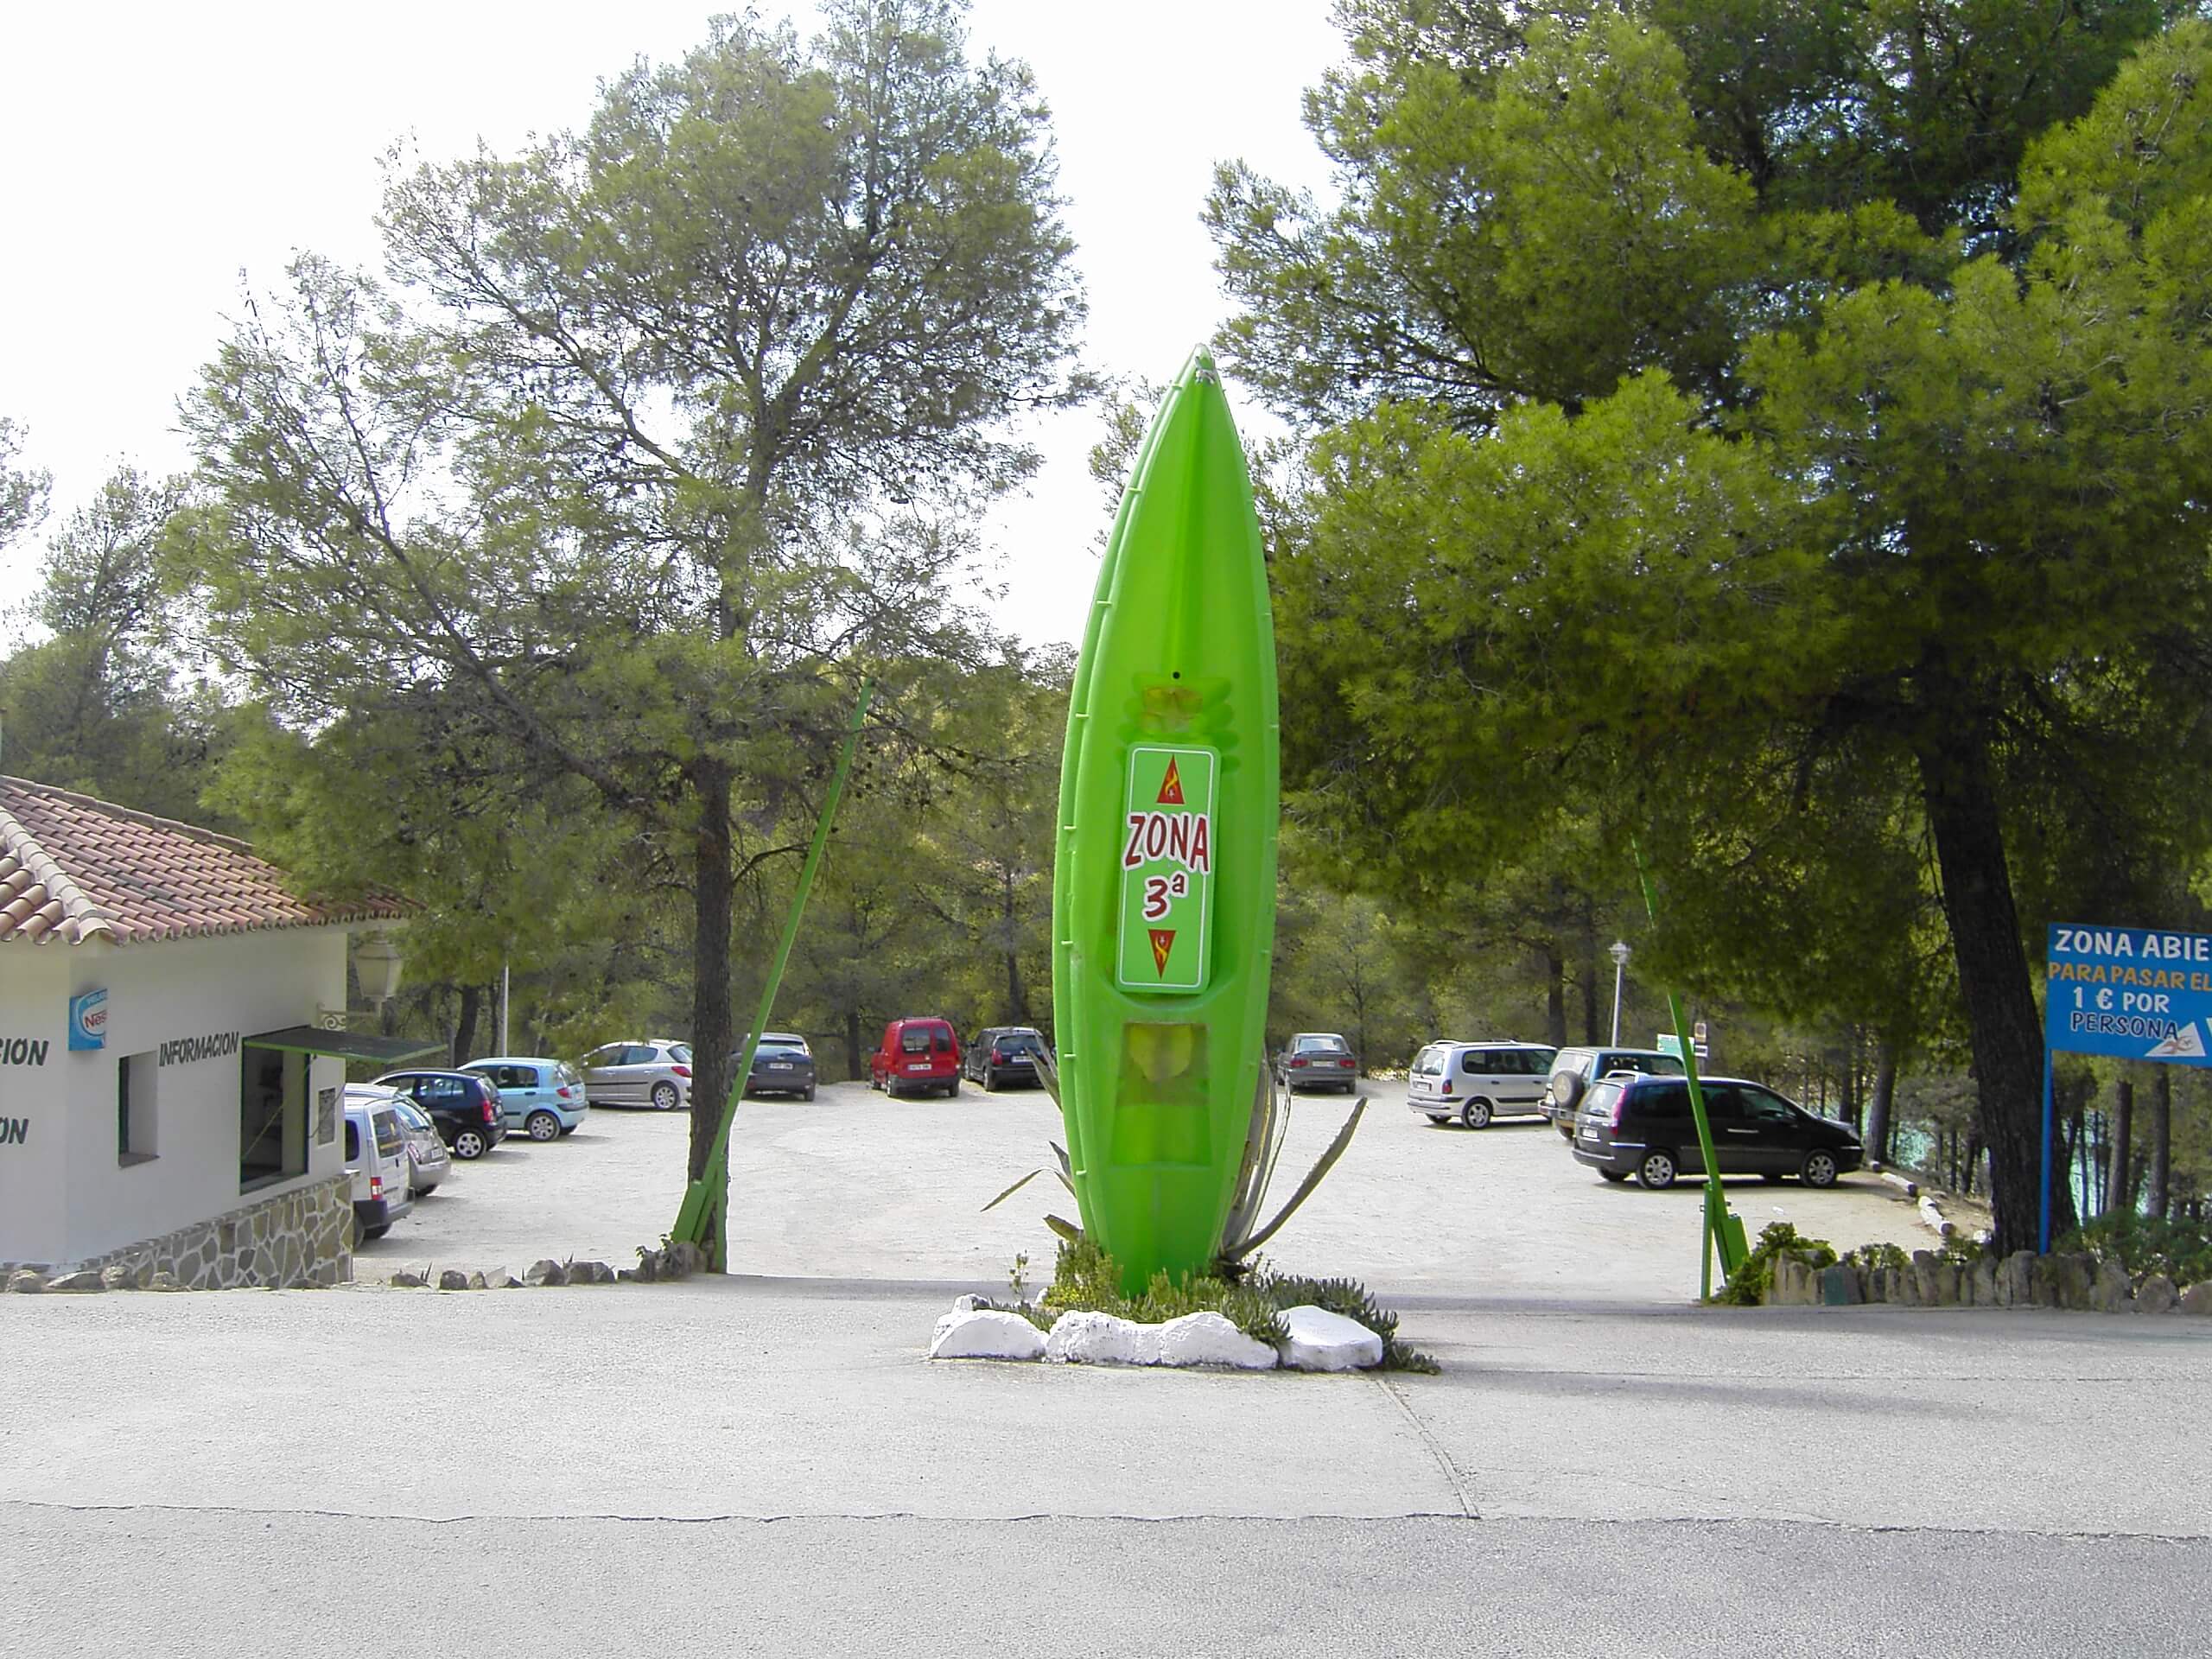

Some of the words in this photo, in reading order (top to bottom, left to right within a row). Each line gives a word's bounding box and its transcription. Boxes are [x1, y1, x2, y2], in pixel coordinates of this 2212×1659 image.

[1124, 813, 1210, 873] ZONA
[2054, 930, 2133, 957] ZONA
[2142, 934, 2209, 961] ABIE
[2048, 962, 2107, 982] PARA
[2111, 965, 2186, 989] PASAR
[2074, 986, 2083, 1009] 1
[2095, 988, 2113, 1010] €
[2122, 991, 2171, 1014] POR
[2070, 1010, 2179, 1040] PERSONA
[159, 1031, 239, 1066] INFORMACION
